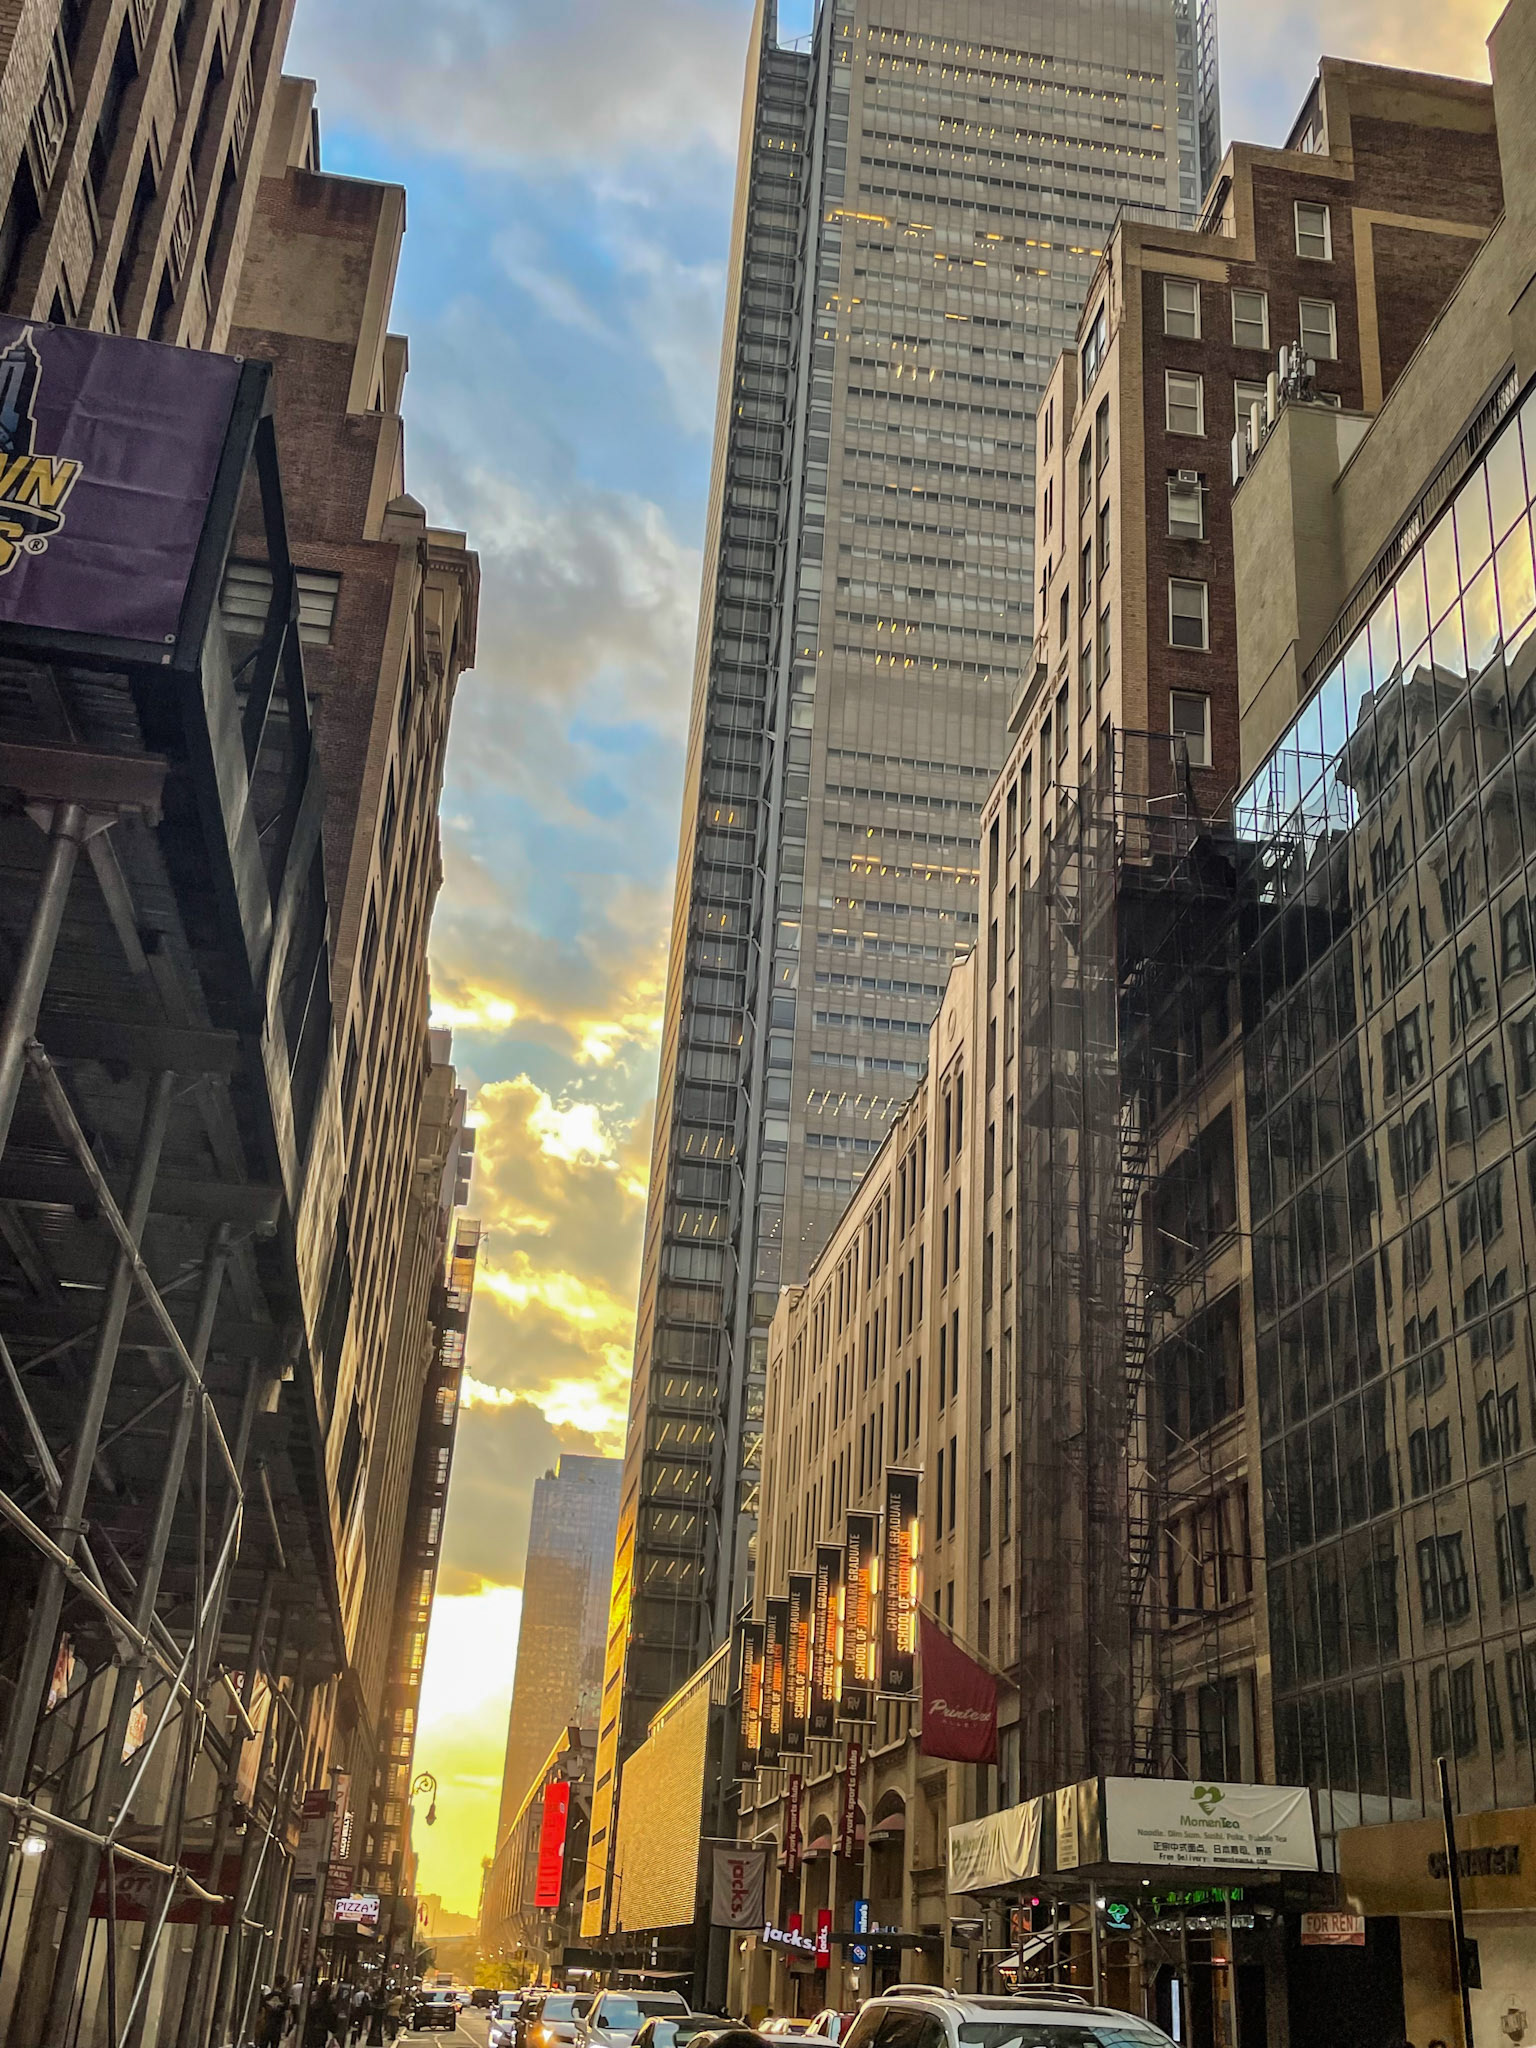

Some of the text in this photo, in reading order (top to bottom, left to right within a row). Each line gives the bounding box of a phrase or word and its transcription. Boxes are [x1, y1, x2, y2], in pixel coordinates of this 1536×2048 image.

[886, 1493, 901, 1632] CRAIG NEWMARK GRADUATE
[817, 1564, 829, 1609] GRADUATE
[845, 1533, 860, 1661] CRAIG NEWMARK GRADUATE
[897, 1531, 911, 1652] SCHOOL OF JOURNALISM
[766, 1615, 777, 1654] GRADUATE
[855, 1568, 869, 1680] SCHOOL OF JOURNALISM
[745, 1638, 755, 1673] GRADUATE
[786, 1592, 800, 1702] CRAIG NEWMARK GRADUATE
[822, 1597, 837, 1700] SCHOOL OF JOURNALISM
[764, 1655, 775, 1692] NEWMARK
[794, 1622, 808, 1719] SCHOOL OF JOURNALISM
[772, 1692, 781, 1703] OF
[749, 1709, 758, 1719] OF
[770, 1703, 780, 1734] SCHOOL
[747, 1720, 757, 1749] SCHOOL
[849, 1750, 858, 1776] clubs
[848, 1777, 856, 1810] sports
[846, 1812, 854, 1834] york
[1168, 1829, 1183, 1838] Dim
[1180, 1815, 1240, 1829] MomenTea
[1159, 1853, 1174, 1861] Free
[727, 1858, 750, 1919] jacks.
[336, 1901, 369, 1913] PIZZA
[858, 1904, 869, 1933] mino's
[763, 1922, 817, 1952] jacks.
[1307, 1915, 1328, 1932] FOR
